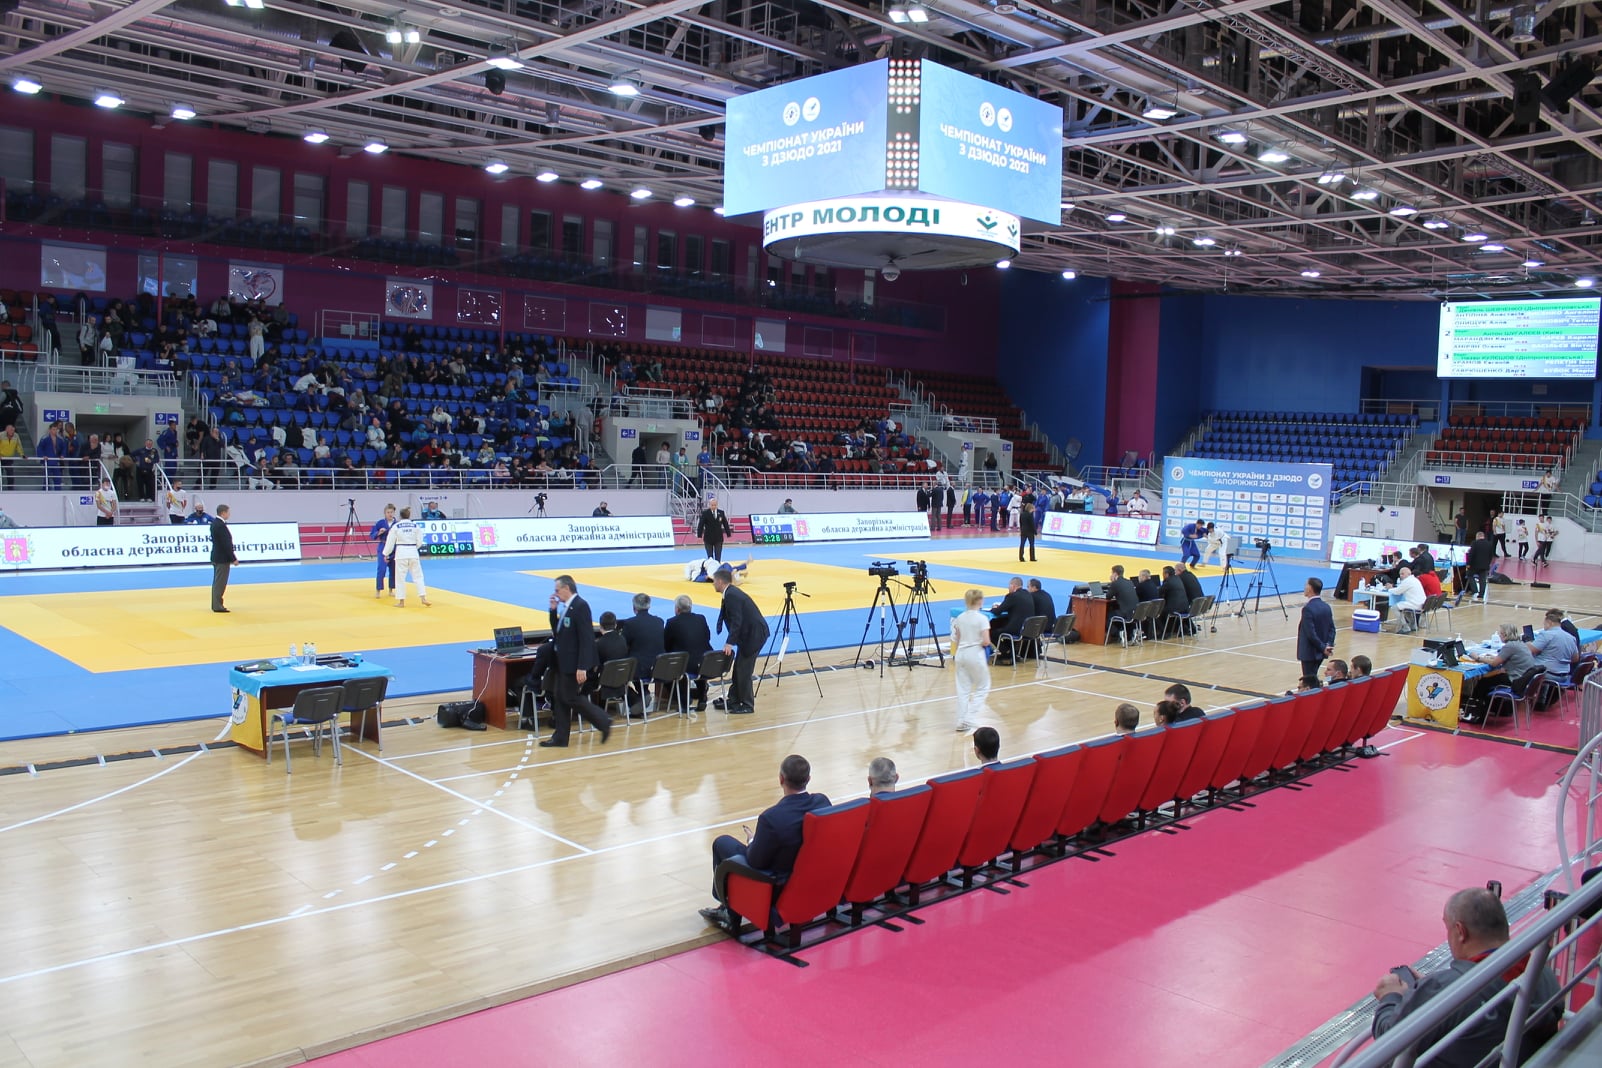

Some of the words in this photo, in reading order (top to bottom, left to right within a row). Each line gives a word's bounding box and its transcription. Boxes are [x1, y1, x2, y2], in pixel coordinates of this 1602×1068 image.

[743, 133, 808, 157] ЧЕМПІОНАТ
[811, 121, 864, 143] УКРАЇНИ
[940, 123, 1002, 152] ЧЕМПІОНАТ
[1003, 143, 1046, 166] УКРАЇНИ
[771, 145, 814, 167] ДЗЮДО
[816, 140, 842, 156] 2021
[967, 145, 1007, 168] ДЗЮДО
[1008, 158, 1029, 174] 2021
[763, 211, 804, 239] ЕНТР
[813, 206, 940, 227] МОЛОДІ
[1188, 469, 1231, 478] ЧЕМПІОНАТ
[1232, 471, 1265, 480] УКРАЇНИ
[1273, 474, 1303, 483] ДЗЮДО
[1213, 478, 1258, 487] ЗАПОРІЖЖЯ
[1260, 479, 1275, 488] 2021
[568, 523, 621, 534] Запорізька
[821, 525, 850, 533] обласна
[851, 525, 884, 534] державна
[885, 523, 928, 532] адміністрація
[856, 518, 893, 526] Запорізька
[142, 533, 214, 545] Запорізьк
[516, 534, 557, 543] обласна
[559, 533, 607, 543] державна
[608, 531, 671, 541] адміністрація
[61, 545, 124, 557] обласна
[128, 544, 199, 557] державна
[202, 540, 296, 554] аністрація
[430, 544, 455, 554] 0:26
